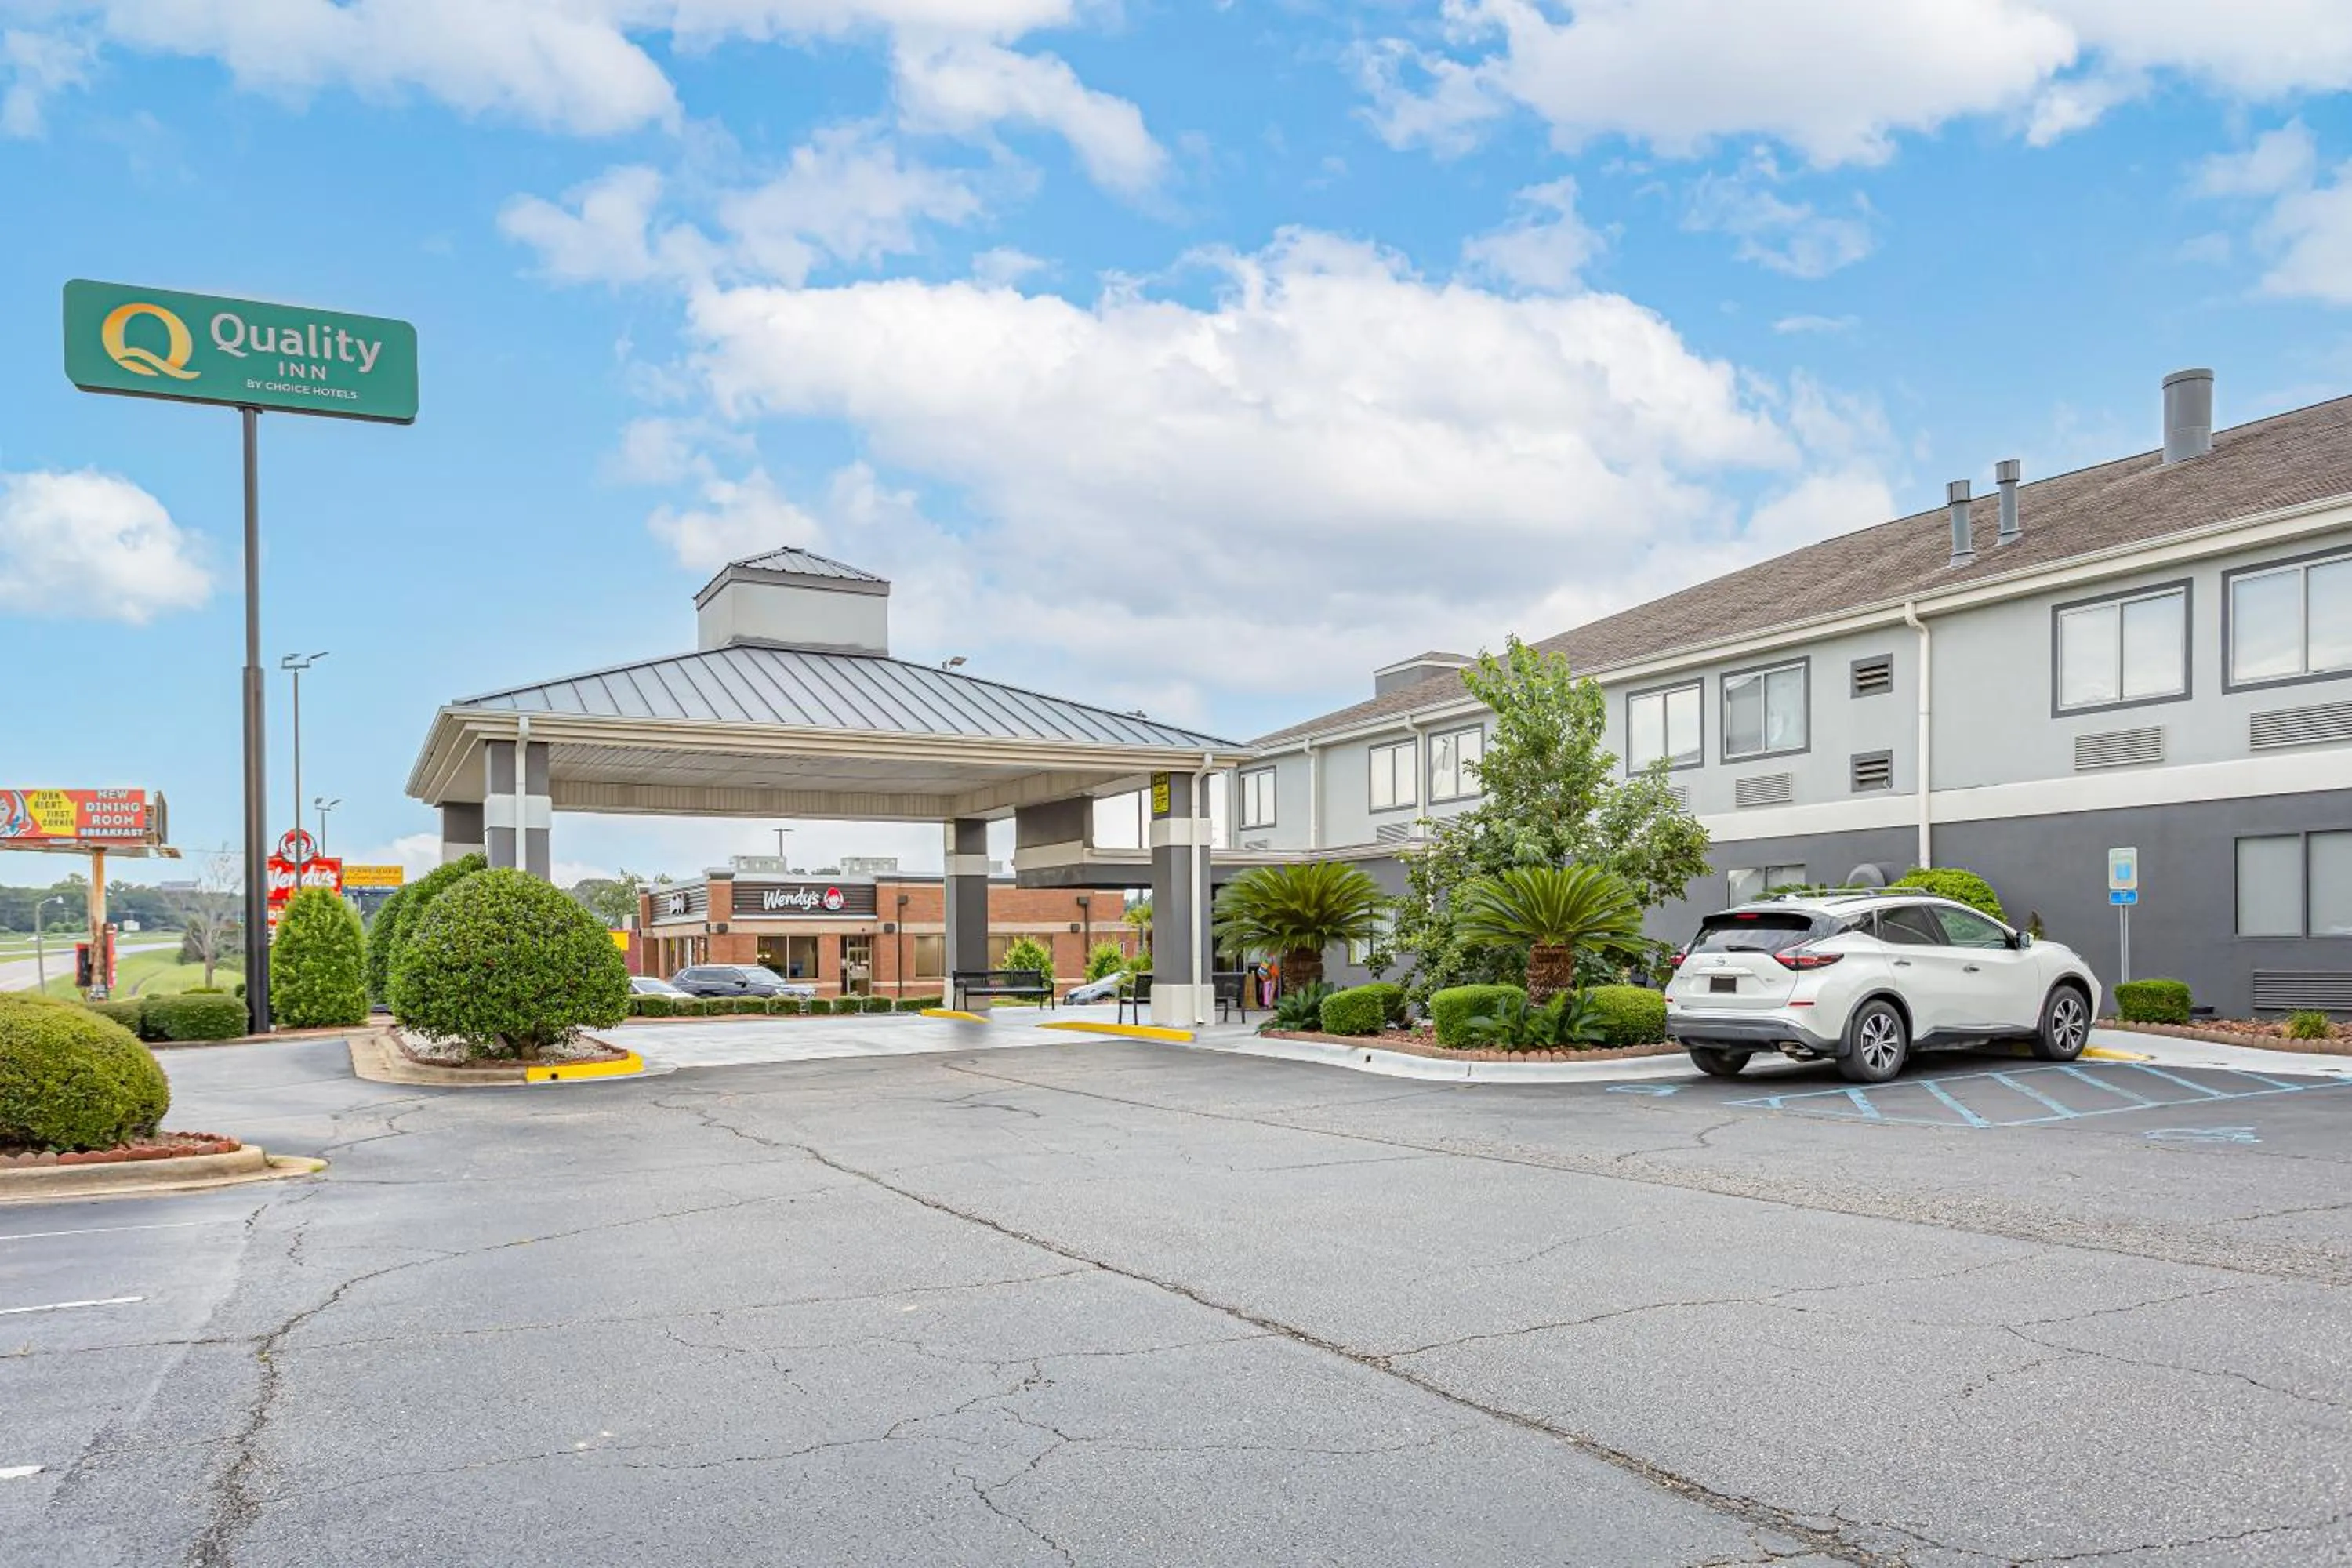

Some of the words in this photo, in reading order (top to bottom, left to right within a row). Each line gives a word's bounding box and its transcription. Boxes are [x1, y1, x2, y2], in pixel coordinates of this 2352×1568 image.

[210, 312, 382, 373] Quality
[278, 361, 327, 380] INN
[246, 379, 261, 390] BY
[265, 382, 310, 394] CHOICE
[313, 387, 358, 400] HOTELS
[98, 789, 129, 799] NEW
[34, 800, 63, 809] RIGHT
[85, 802, 140, 812] DINING
[92, 815, 134, 825] ROOM
[79, 828, 143, 837] BREAKFAST
[763, 887, 819, 910] Wendy's
